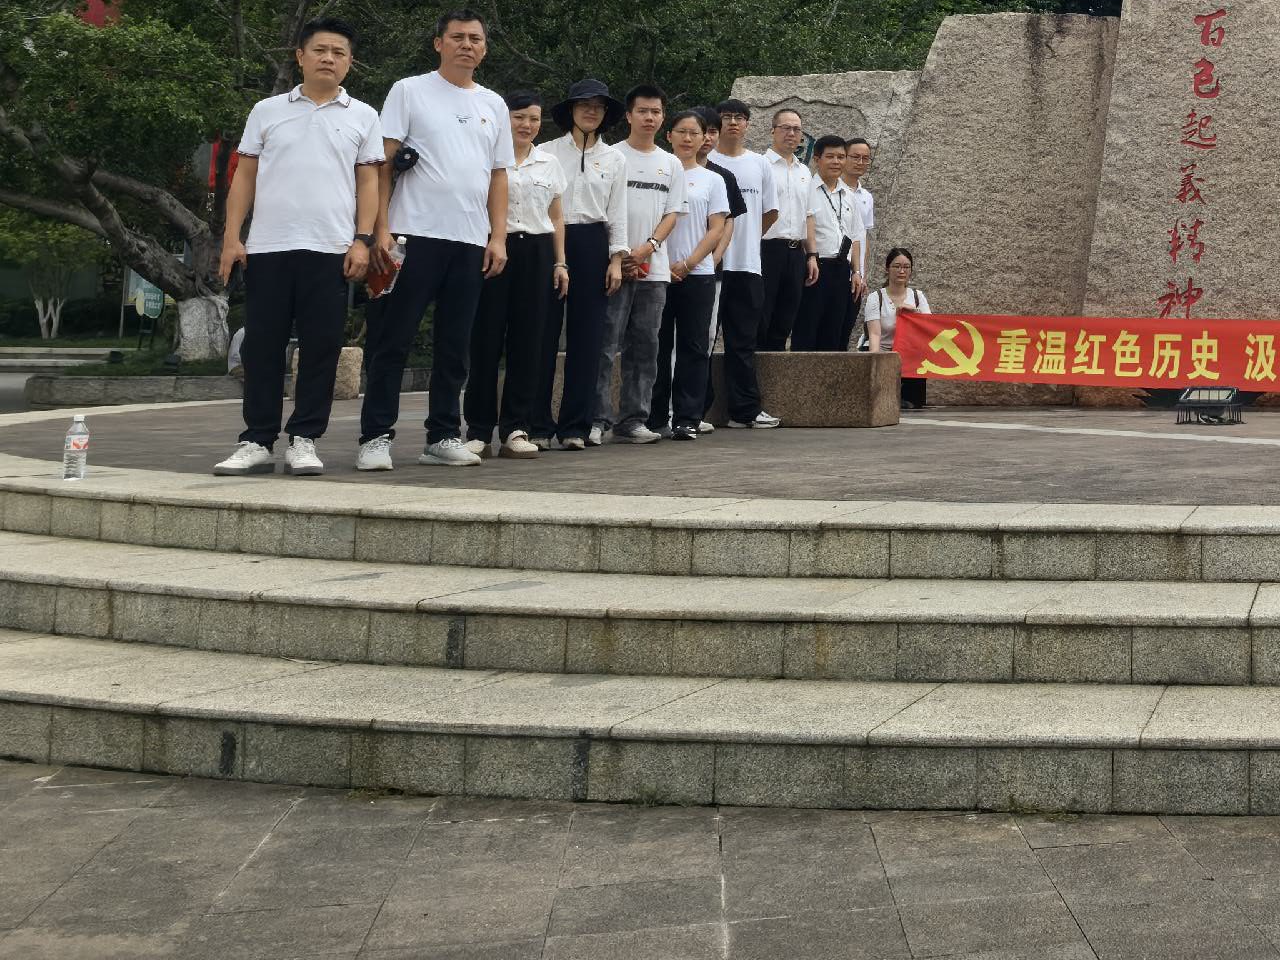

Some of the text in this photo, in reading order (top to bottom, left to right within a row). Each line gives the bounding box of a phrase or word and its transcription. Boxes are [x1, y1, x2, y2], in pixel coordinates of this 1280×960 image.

[994, 328, 1220, 380] 重温红色历史
